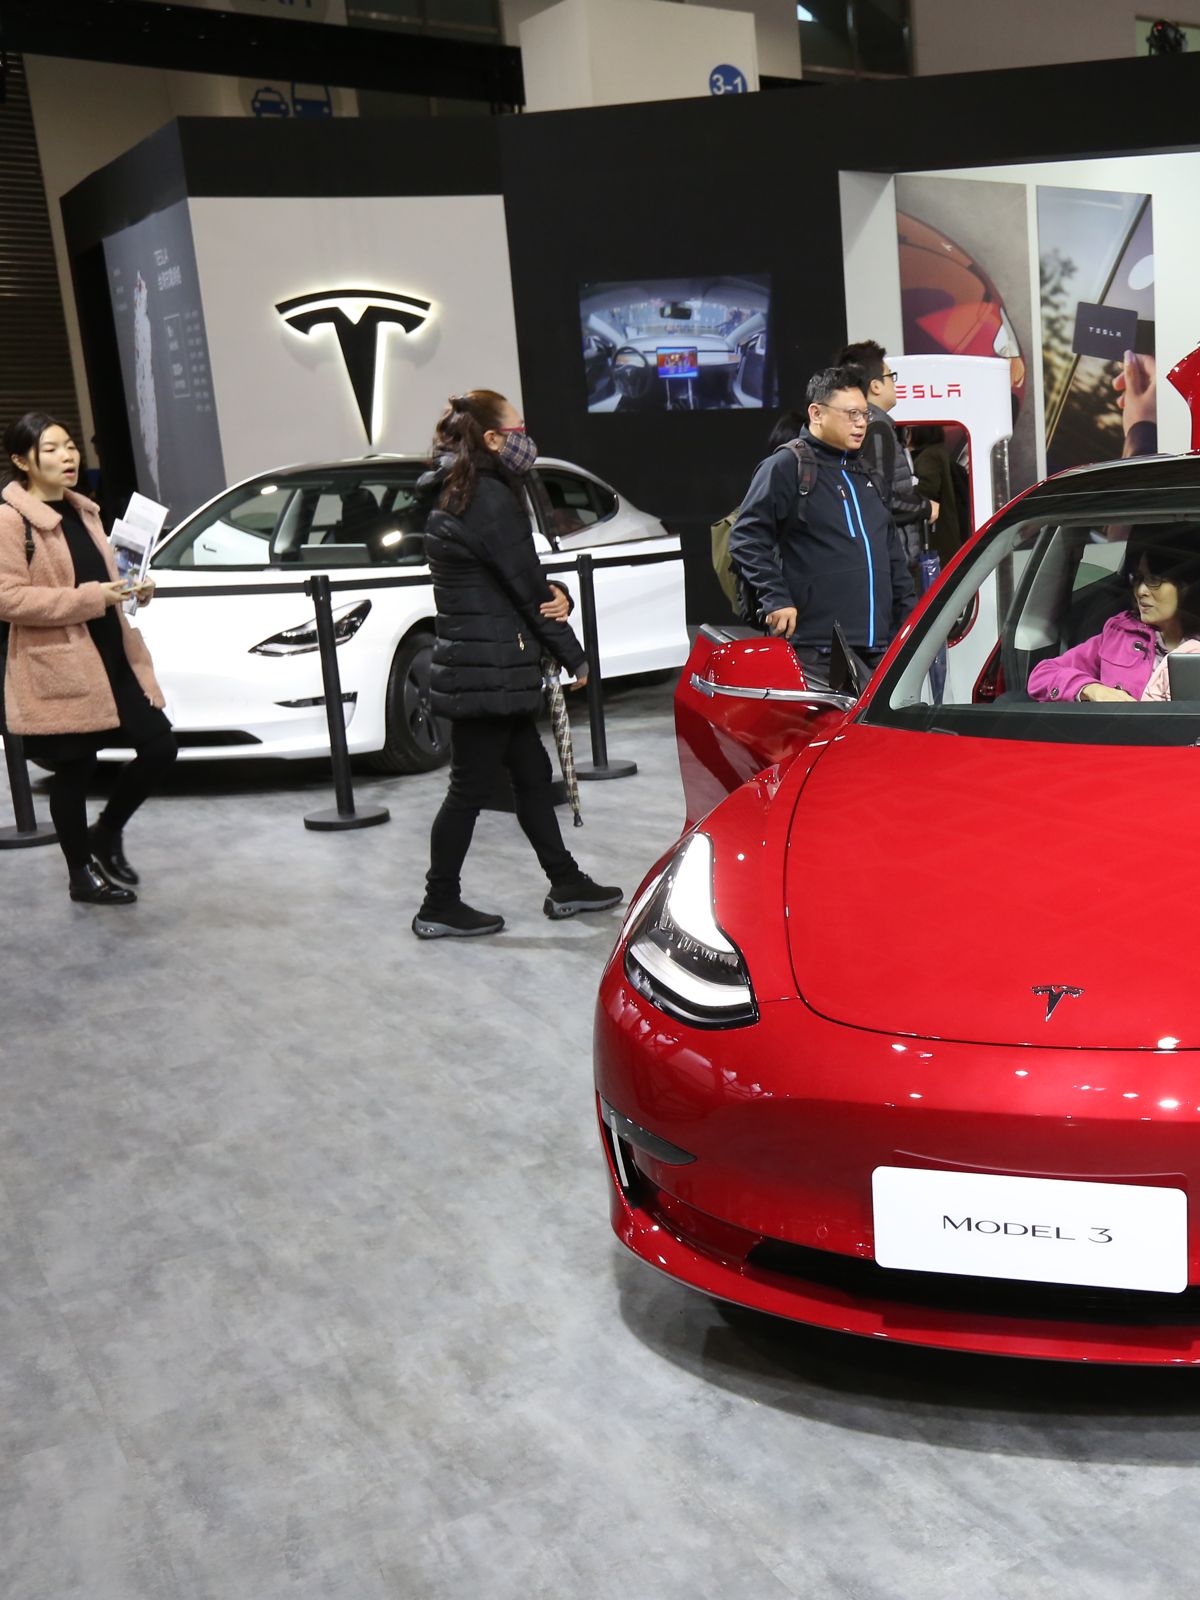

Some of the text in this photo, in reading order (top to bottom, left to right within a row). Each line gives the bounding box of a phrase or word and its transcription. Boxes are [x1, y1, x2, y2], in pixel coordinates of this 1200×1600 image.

[712, 74, 743, 95] 3-1
[1088, 326, 1122, 337] TESLA
[895, 384, 962, 399] ESLA
[942, 1214, 1114, 1244] MODEL 3
